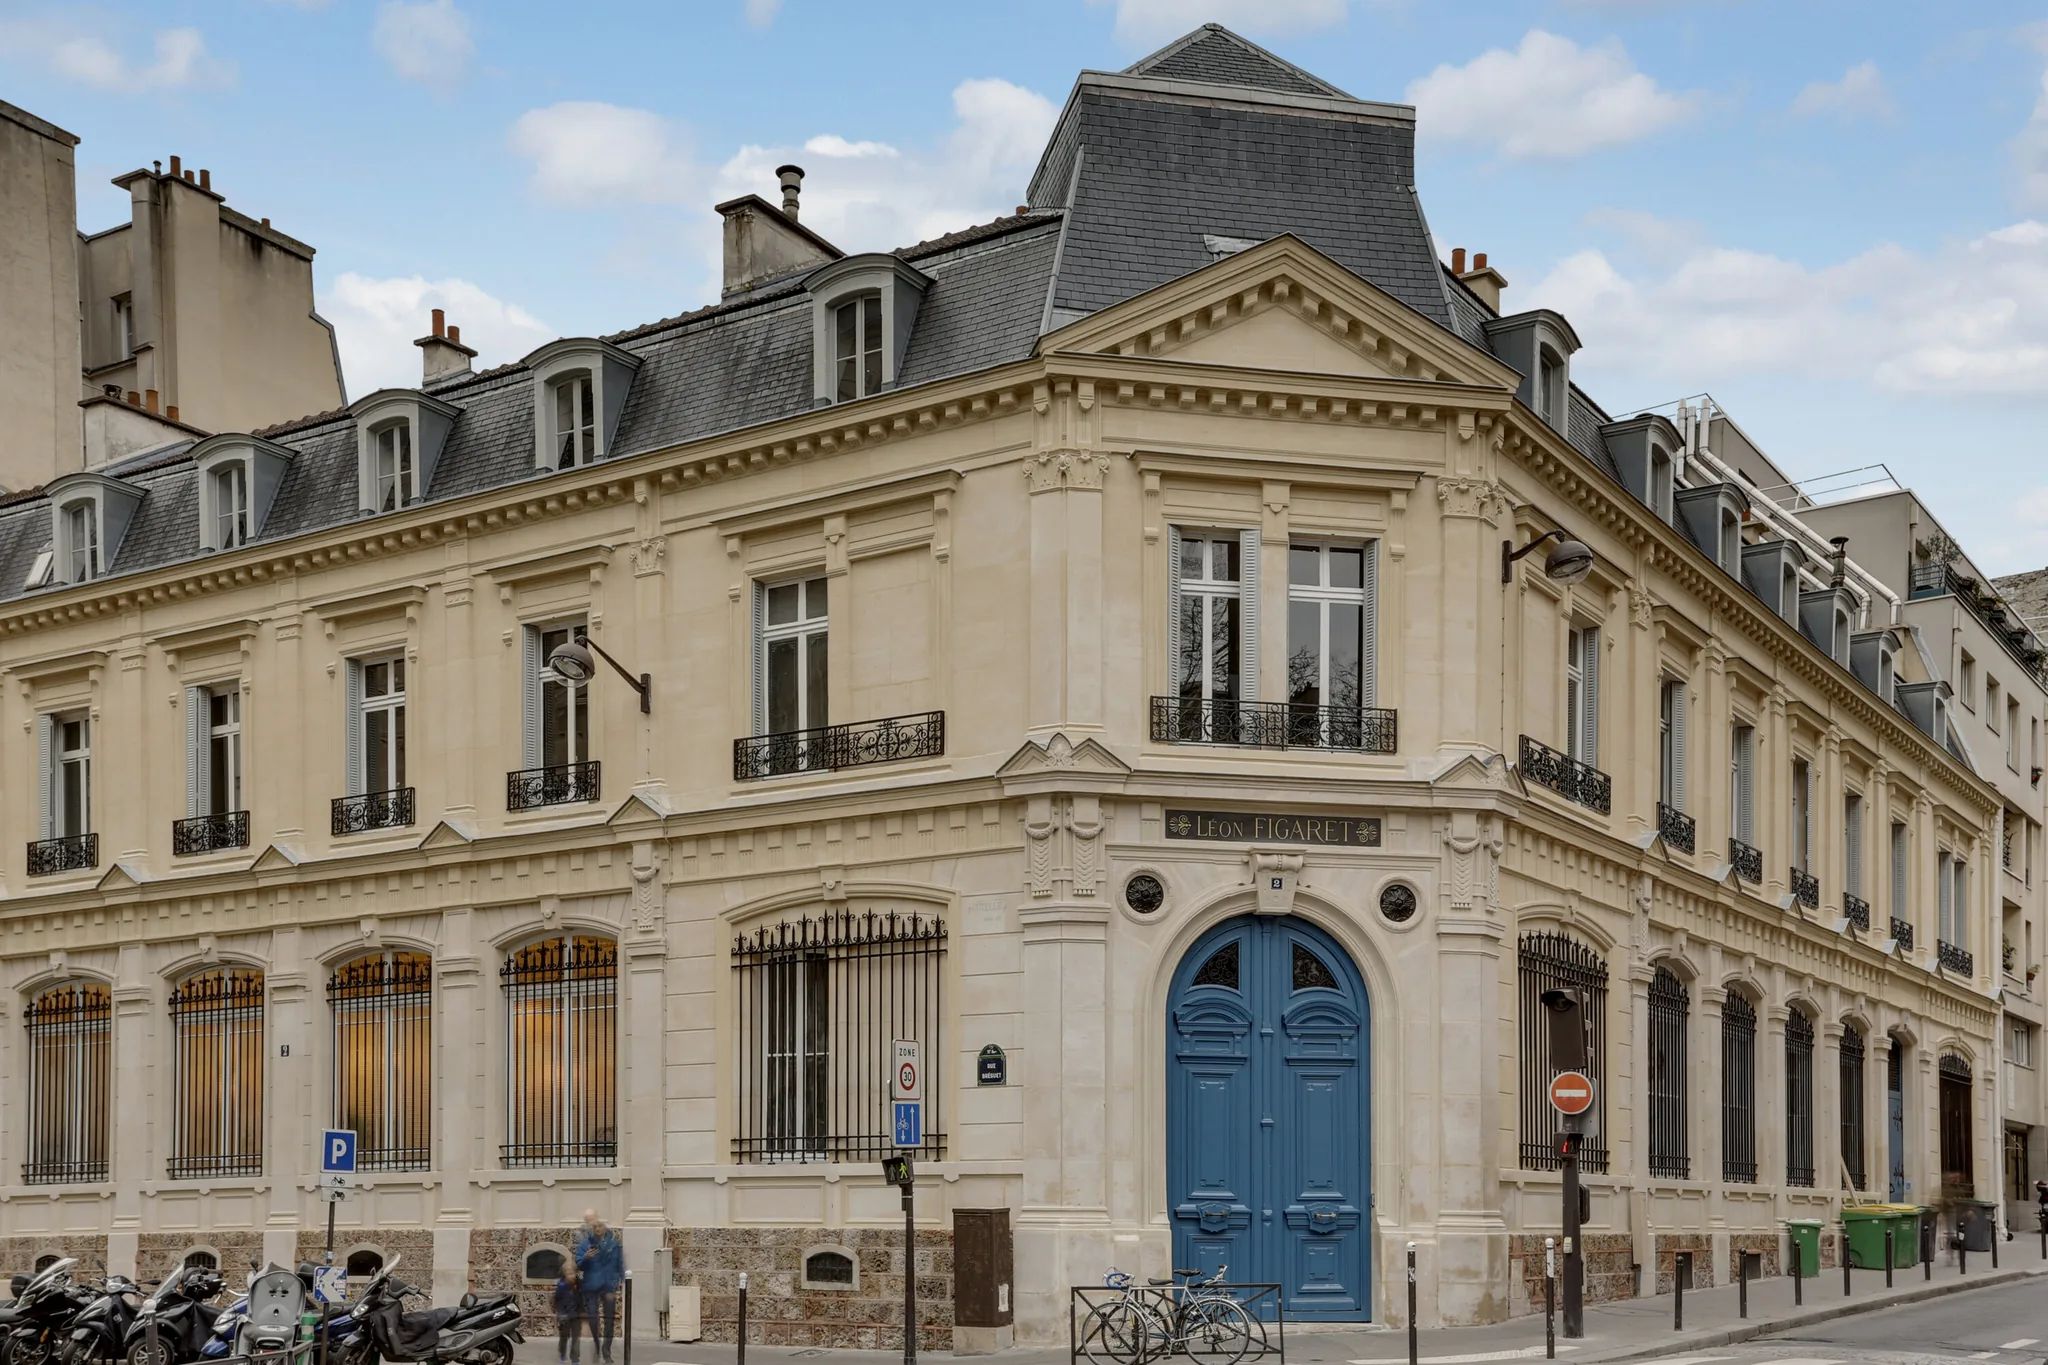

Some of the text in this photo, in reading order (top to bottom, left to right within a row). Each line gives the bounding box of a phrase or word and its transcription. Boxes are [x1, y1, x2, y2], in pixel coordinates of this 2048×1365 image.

[1197, 815, 1354, 843] LÉON FIGARET
[1273, 879, 1280, 888] 2
[899, 1048, 916, 1057] ZONE
[903, 1071, 912, 1082] 30
[331, 1138, 347, 1165] P
